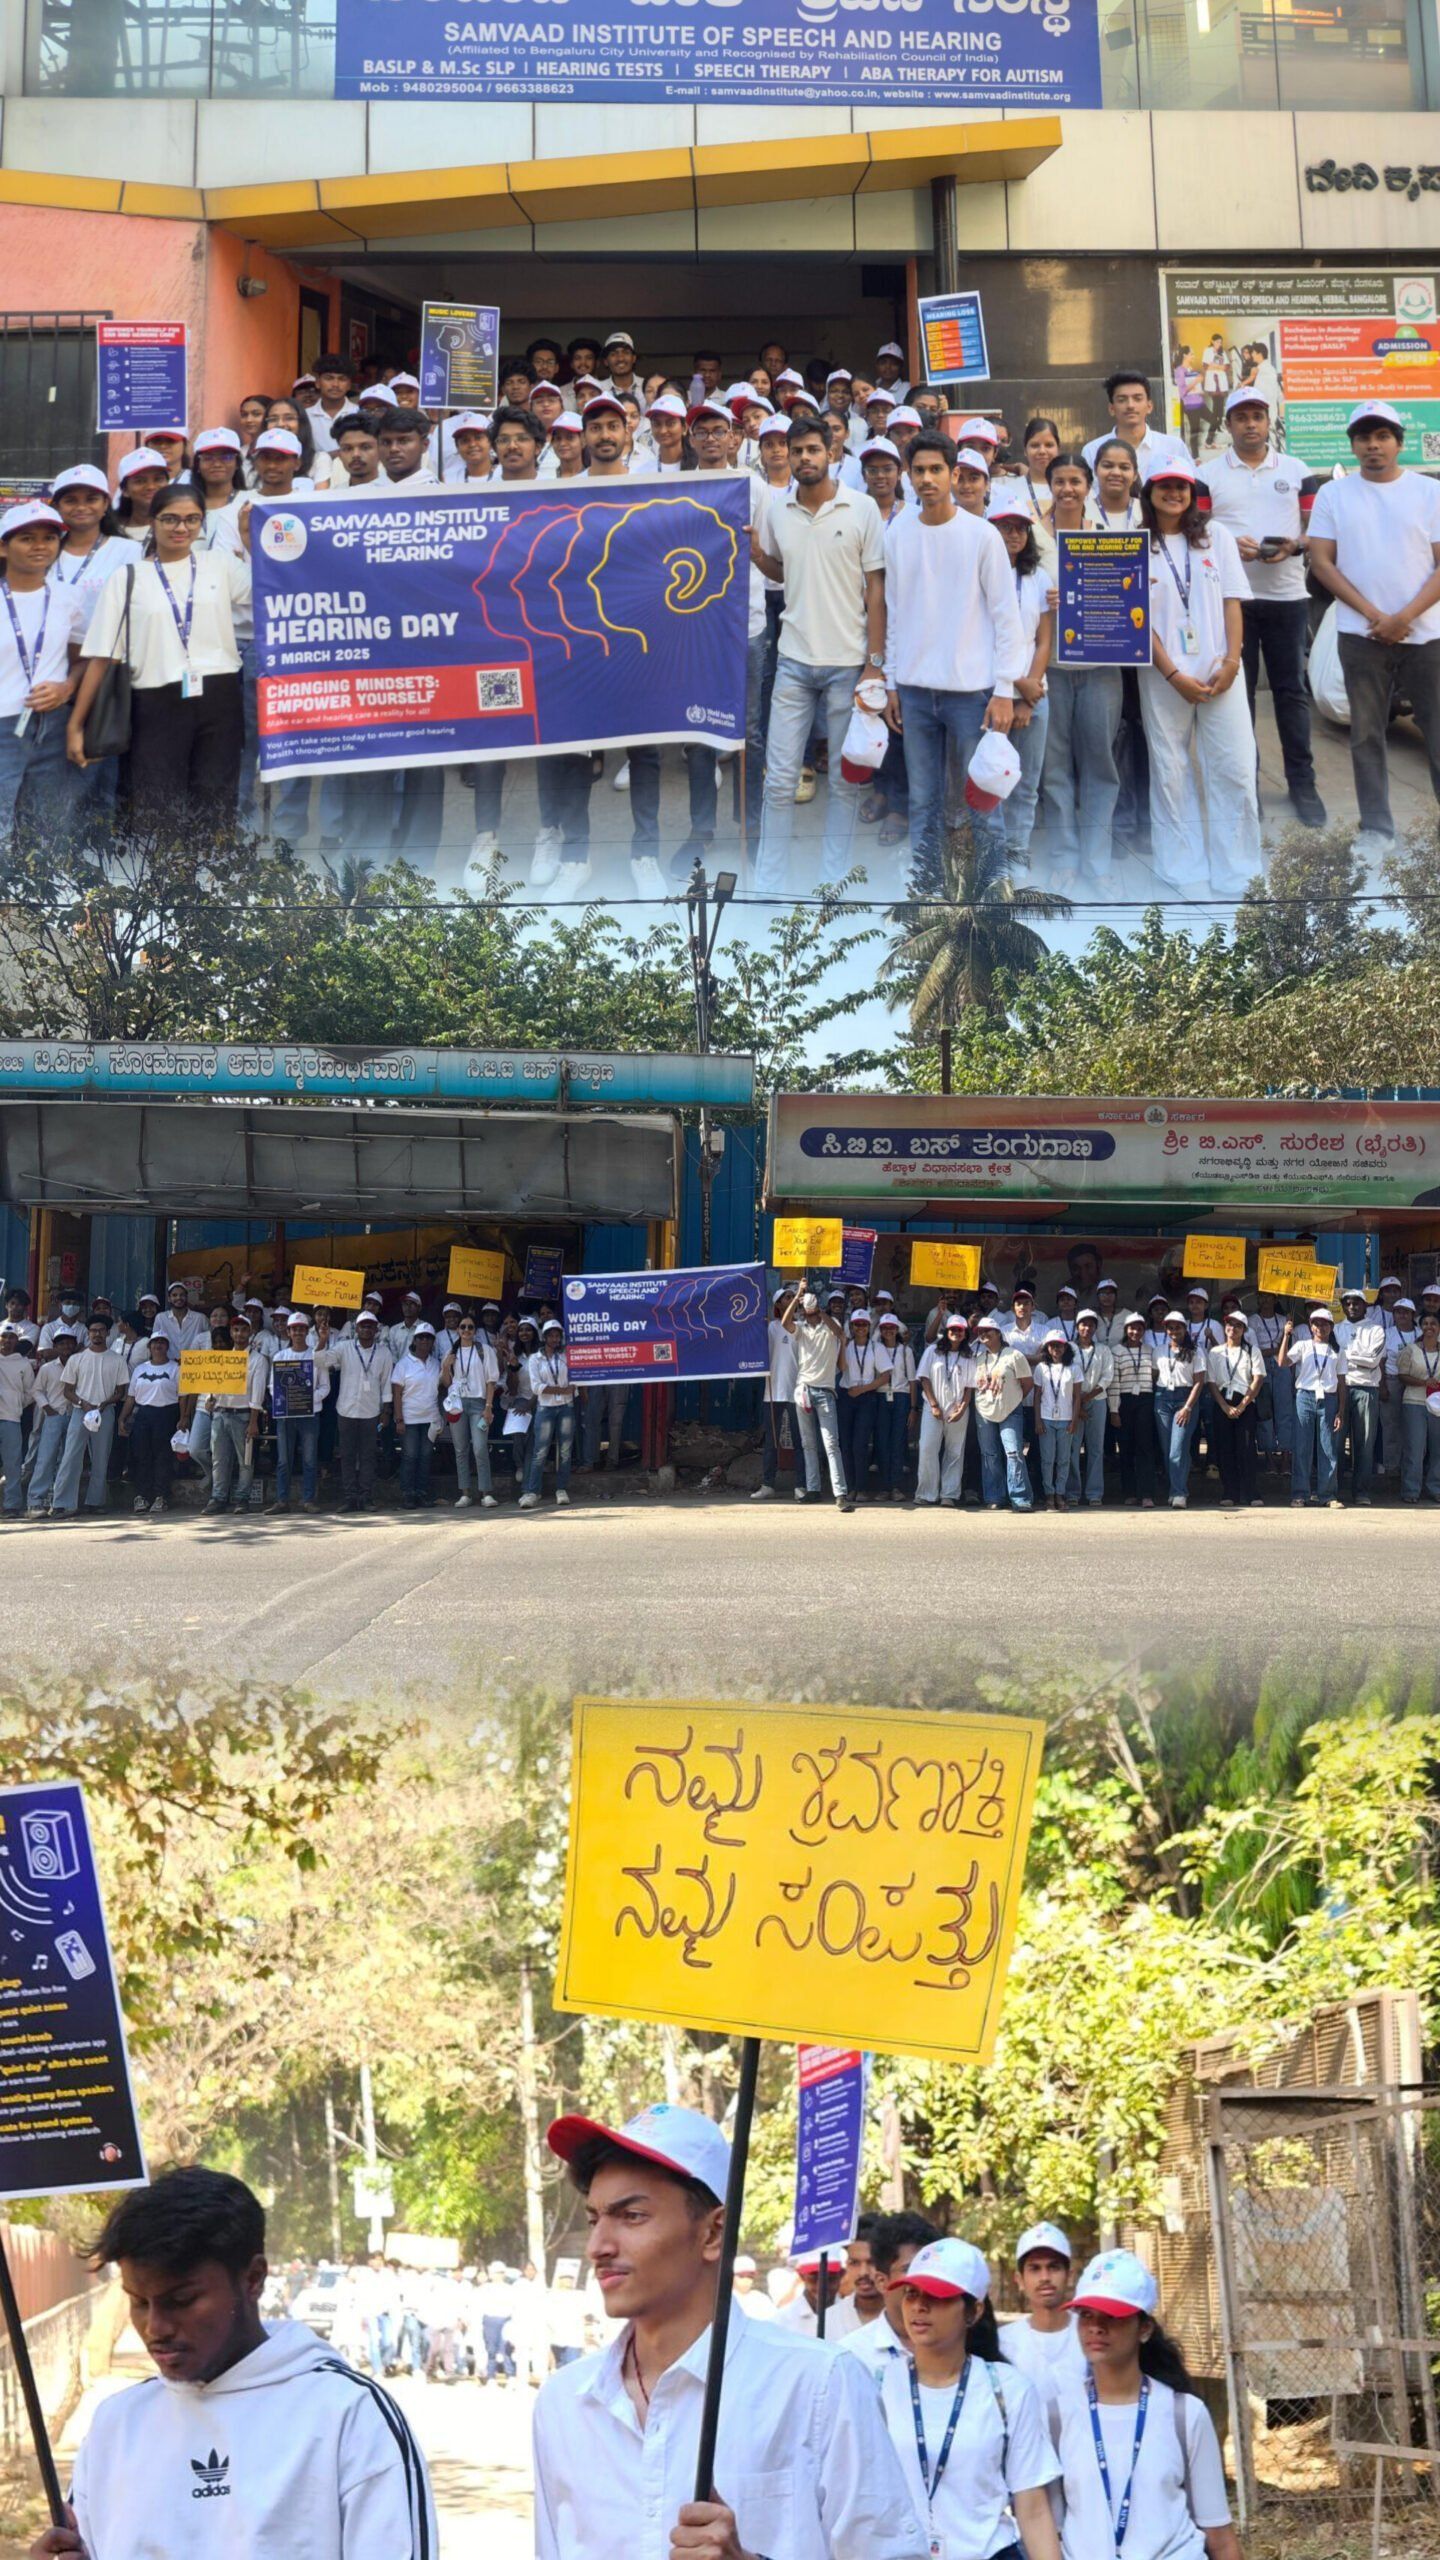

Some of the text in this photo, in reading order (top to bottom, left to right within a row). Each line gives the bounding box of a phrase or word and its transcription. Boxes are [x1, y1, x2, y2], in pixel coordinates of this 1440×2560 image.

[444, 22, 1002, 51] SAMVAAD INSTITUTE OF SPEECH AND HEARING
[448, 45, 510, 56] (Affiliated
[513, 46, 526, 56] to
[530, 46, 595, 57] Bengaluru
[600, 47, 625, 58] City
[629, 47, 691, 59] University
[695, 48, 719, 58] and
[723, 49, 796, 61] Recognised
[799, 50, 814, 61] by
[901, 53, 946, 63] Council
[950, 53, 961, 63] of
[965, 53, 999, 65] India)
[363, 60, 515, 75] BASLP & M.Sc SLP
[536, 62, 663, 77] HEARING TESTS
[694, 64, 831, 79] SPEECH THERAPY
[860, 66, 1063, 83] ABA THERAPY FOR AUTISM
[360, 82, 574, 94] Mob 9480295004 9663388623
[666, 86, 700, 96] E-mail
[884, 89, 924, 98] website
[934, 91, 1071, 102] www.samvaadinstitute.org
[1378, 342, 1428, 350] ADMISSION
[310, 507, 510, 532] SAMVAAD INSTITUTE
[332, 525, 488, 548] OF SPEECH AND
[366, 544, 454, 564] HEARING
[264, 591, 366, 619] WORLD
[266, 612, 459, 646] HEARING DAY
[266, 648, 370, 667] 3 MARCH 2025
[266, 675, 440, 699] CHANGING MINDSETS:
[266, 690, 435, 715] EMPOWER YOURSELF
[266, 718, 289, 728] Make
[306, 715, 321, 724] and
[323, 712, 353, 724] hearing
[355, 711, 371, 720] care
[380, 708, 404, 719] reality
[266, 726, 455, 750] You can take steps today to ensure good hearing
[266, 743, 357, 760] health throughout life.
[108, 1045, 218, 1080] ಸೋಮನಾಥ
[227, 1048, 274, 1077] ಅವರ
[523, 1057, 557, 1080] ಬಸ್
[909, 1133, 961, 1157] ಬಸ್
[972, 1131, 1093, 1158] ತಂಗುದಾಣ
[1162, 1130, 1189, 1155] ಶ್ರೀ
[1279, 1133, 1345, 1152] ಸುರೇಶ
[1271, 1264, 1312, 1280] HEAR WELL
[587, 1281, 627, 1289] SAMVAAD
[567, 1312, 610, 1323] WORLD
[568, 1321, 647, 1334] HEARING DAY
[624, 1725, 763, 1847] ನಮ್ಮ
[615, 1844, 737, 1969] ನಮ್ಮ
[20, 2002, 69, 2016] quiet zones
[27, 2032, 53, 2042] levels
[50, 2041, 92, 2051] smartphone
[47, 2055, 109, 2070] after the event
[56, 2088, 77, 2098] from
[77, 2084, 115, 2097] speakers
[18, 2116, 93, 2130] for sound systems
[36, 2130, 67, 2139] listening
[67, 2126, 101, 2137] standards
[191, 2483, 231, 2499] adidas
